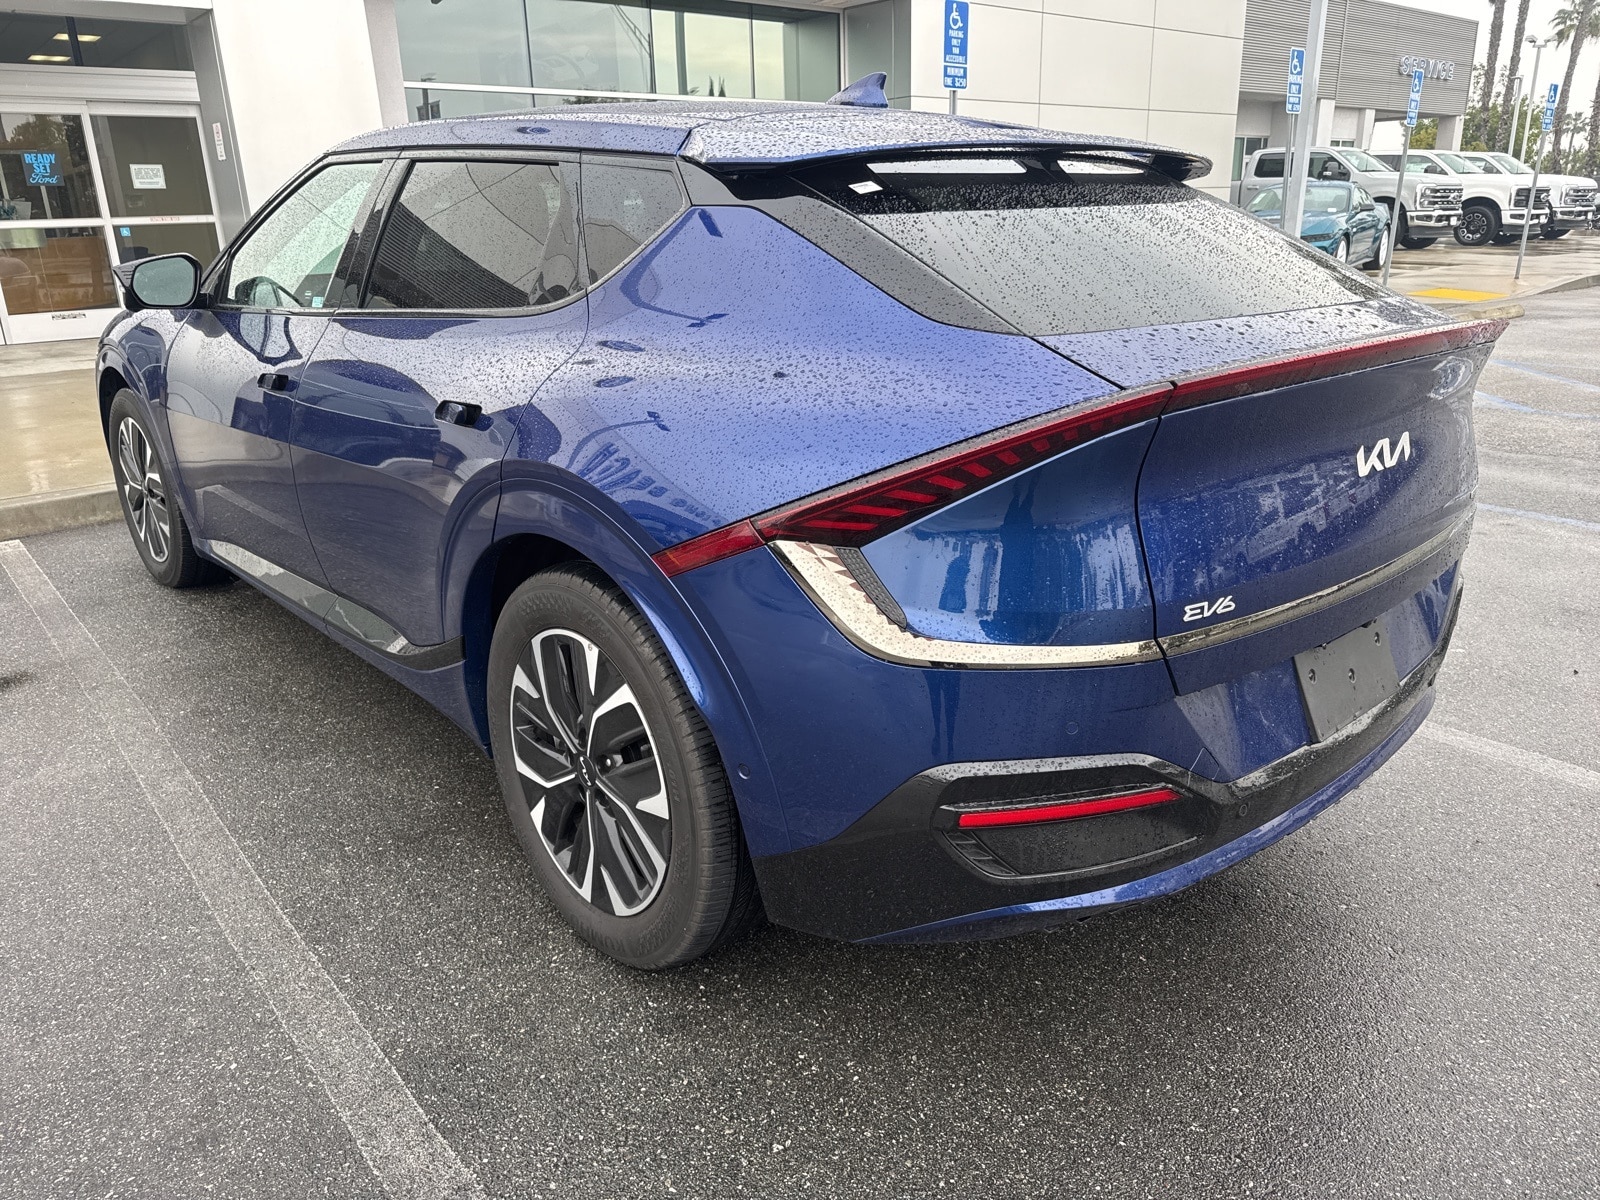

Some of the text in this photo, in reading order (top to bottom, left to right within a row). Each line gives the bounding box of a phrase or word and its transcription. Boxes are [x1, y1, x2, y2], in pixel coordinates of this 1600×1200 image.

[948, 29, 964, 38] PARKING
[951, 38, 961, 46] ONLY
[952, 46, 960, 54] VAN
[1401, 55, 1454, 80] SERVICE
[954, 77, 966, 87] $250
[23, 153, 56, 164] READY
[33, 163, 51, 173] SET
[29, 173, 58, 184] Ford
[1356, 431, 1411, 478] KIA
[1182, 595, 1236, 622] EV6
